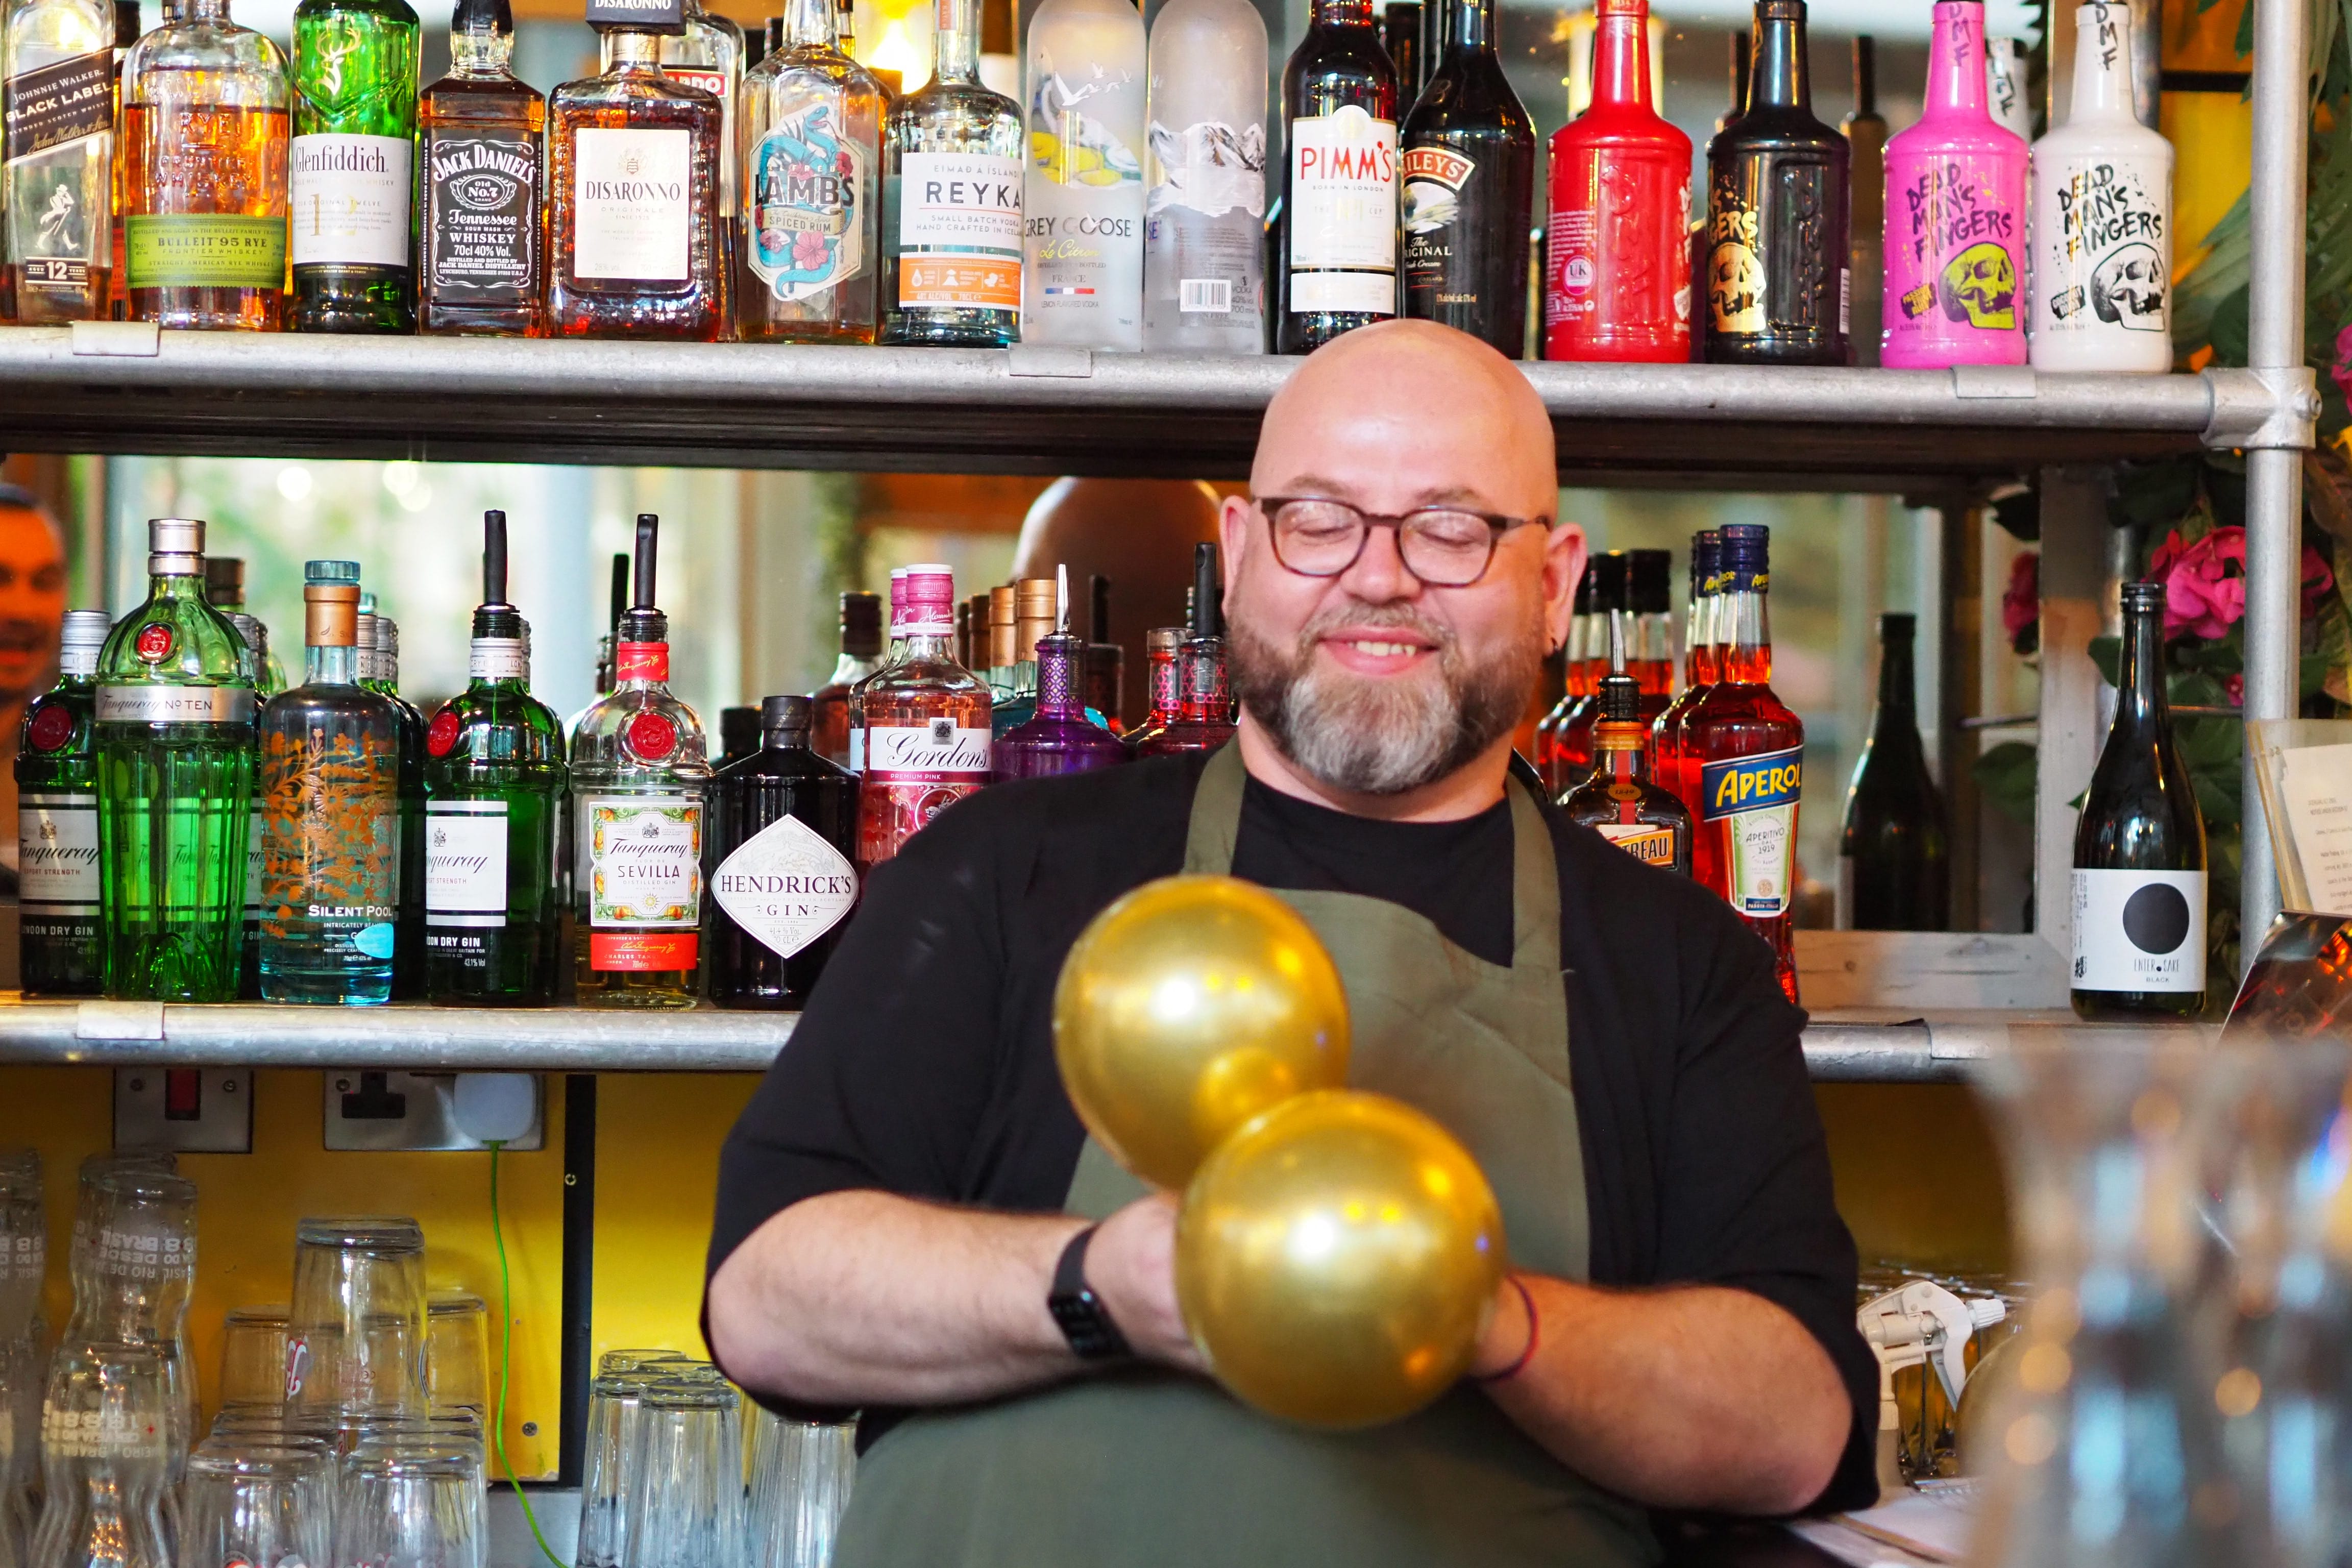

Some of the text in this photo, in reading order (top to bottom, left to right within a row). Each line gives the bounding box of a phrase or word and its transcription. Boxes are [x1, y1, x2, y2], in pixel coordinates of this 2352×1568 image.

[14, 69, 101, 104] JOHNNIE WALKER
[6, 82, 111, 122] BLACK LABEL
[47, 111, 77, 123] SCOTCH
[81, 101, 109, 113] WHISKY
[296, 145, 386, 173] Glenfiddich
[432, 144, 537, 184] JACK DANIEL'S
[1301, 141, 1392, 183] PIMM'S
[585, 181, 680, 203] DISARONNO
[926, 181, 1021, 210] REYKA
[1906, 163, 1961, 212] DEAD
[2057, 164, 2114, 211] DEAD
[449, 209, 517, 226] Tennessee
[770, 216, 805, 229] SPICED
[810, 222, 831, 232] RUM
[968, 216, 996, 224] BATCH
[1000, 219, 1019, 227] VODKA
[947, 225, 989, 233] CRAFTED
[1025, 217, 1056, 237] GREY
[1063, 217, 1131, 237] GOOSE
[1915, 209, 2013, 262] FINGERS
[158, 237, 213, 246] BULLEIT
[245, 238, 267, 247] RYE
[450, 233, 516, 243] WHISKEY
[2067, 211, 2162, 263] FINGERS
[454, 244, 511, 257] 70cl 40% Vol.
[46, 261, 67, 279] 12
[1570, 264, 1587, 276] UK
[103, 695, 160, 713] Tanqueray
[185, 700, 212, 710] TEN
[887, 732, 988, 769] Gordon's
[1716, 764, 1801, 807] APEROL
[1746, 827, 1784, 842] APERITIVO
[20, 839, 99, 865] Tanqueray
[610, 838, 688, 858] Tanqueray
[1758, 845, 1775, 854] 1919
[618, 865, 680, 877] SEVILLA
[721, 875, 851, 894] HENDRICK'S
[308, 904, 393, 917] SILENT POOL
[767, 904, 808, 916] GIN
[50, 926, 70, 935] DRY
[75, 926, 93, 935] GIN
[441, 937, 480, 947] DRY GIN
[464, 959, 477, 967] 43.1%
[2134, 958, 2179, 972] ENTER SAKE
[132, 1267, 155, 1278] RIO
